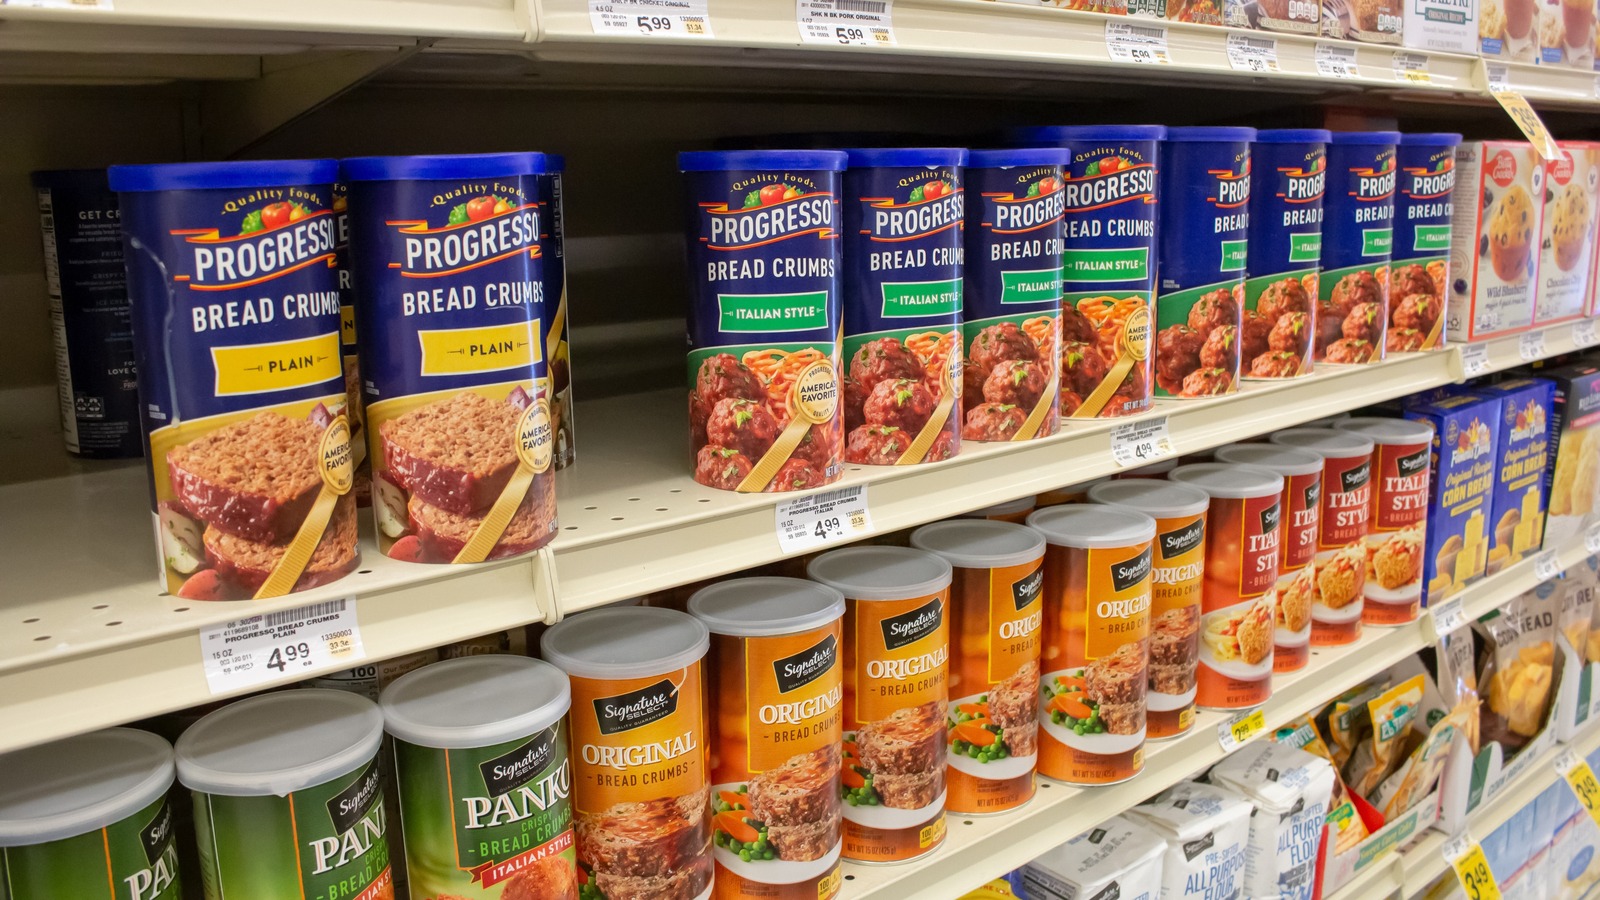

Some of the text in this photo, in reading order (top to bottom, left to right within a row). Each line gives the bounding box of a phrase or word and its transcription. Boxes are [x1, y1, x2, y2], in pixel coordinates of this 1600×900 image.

[1075, 146, 1142, 163] Quality Foods
[732, 172, 814, 191] Quality Foods
[899, 169, 939, 187] Quality
[1018, 167, 1052, 184] Quality
[432, 182, 525, 206] Quality Foods
[1065, 169, 1153, 207] ROGRESSO
[224, 187, 321, 213] Quality Foods
[79, 211, 101, 219] GET
[711, 199, 832, 244] PROGRESSO
[1283, 209, 1317, 227] BREAD
[1355, 206, 1388, 223] BREAD
[1408, 203, 1442, 220] BREAD
[1064, 218, 1154, 238] READ CRUMBS
[1214, 215, 1247, 234] BREAD
[194, 217, 335, 282] PROGRESSO
[405, 212, 539, 270] PROGRESSO
[991, 239, 1041, 261] BREAD
[708, 257, 835, 282] BREAD CRUMBS
[870, 248, 927, 271] BREAD
[1075, 260, 1139, 271] ITALIAN STYLE
[1017, 281, 1050, 293] ITALIAN
[403, 280, 544, 317] BREAD CRUMBS
[900, 292, 958, 305] ITALIAN STYLE
[192, 297, 274, 333] BREAD
[283, 291, 340, 321] CRUMBS
[736, 306, 815, 319] ITALIAN STYLE
[469, 341, 513, 357] PLAIN
[269, 355, 314, 374] PLAIN
[801, 389, 836, 403] FAVORITE
[1502, 451, 1547, 482] CORN BREAD
[1443, 472, 1492, 508] CORN BREAD
[820, 501, 836, 509] BREAD
[1392, 492, 1428, 511] STYL
[1155, 588, 1182, 598] BREAD
[225, 613, 340, 644] PROGRESSO BREAD CRUMBS
[890, 610, 937, 637] Signature
[908, 617, 938, 636] SELECT
[1108, 622, 1136, 634] BREAD
[272, 630, 296, 640] PLAIN
[212, 649, 233, 660] 15 OZ
[1010, 641, 1033, 654] BREAD
[349, 665, 376, 678] 100
[784, 647, 832, 679] Signature
[803, 655, 832, 676] SELECT
[866, 643, 949, 681] ORIGINAL
[880, 673, 946, 696] BREAD CRUMBS
[604, 692, 667, 722] Signature
[626, 701, 667, 721] SELECT
[759, 681, 842, 725] ORIGINAL
[609, 709, 669, 732] QUALITY GUARANTEED
[774, 713, 841, 743] BREAD CRUMBS
[582, 730, 697, 771] ORIGINAL
[493, 742, 549, 782] Signature
[515, 750, 550, 778] SELECT
[597, 765, 689, 787] BREAD CRUMBS
[462, 757, 571, 830] PANKO
[480, 804, 572, 857] BREAD CRUMBS
[521, 811, 553, 832] CRISPY
[921, 828, 932, 839] 100
[1277, 831, 1291, 857] ALL
[492, 834, 572, 880] ITALIAN STYLE
[847, 843, 856, 852] NET
[328, 867, 373, 900] BREAD
[819, 879, 830, 891] 100
[1184, 871, 1206, 897] ALL
